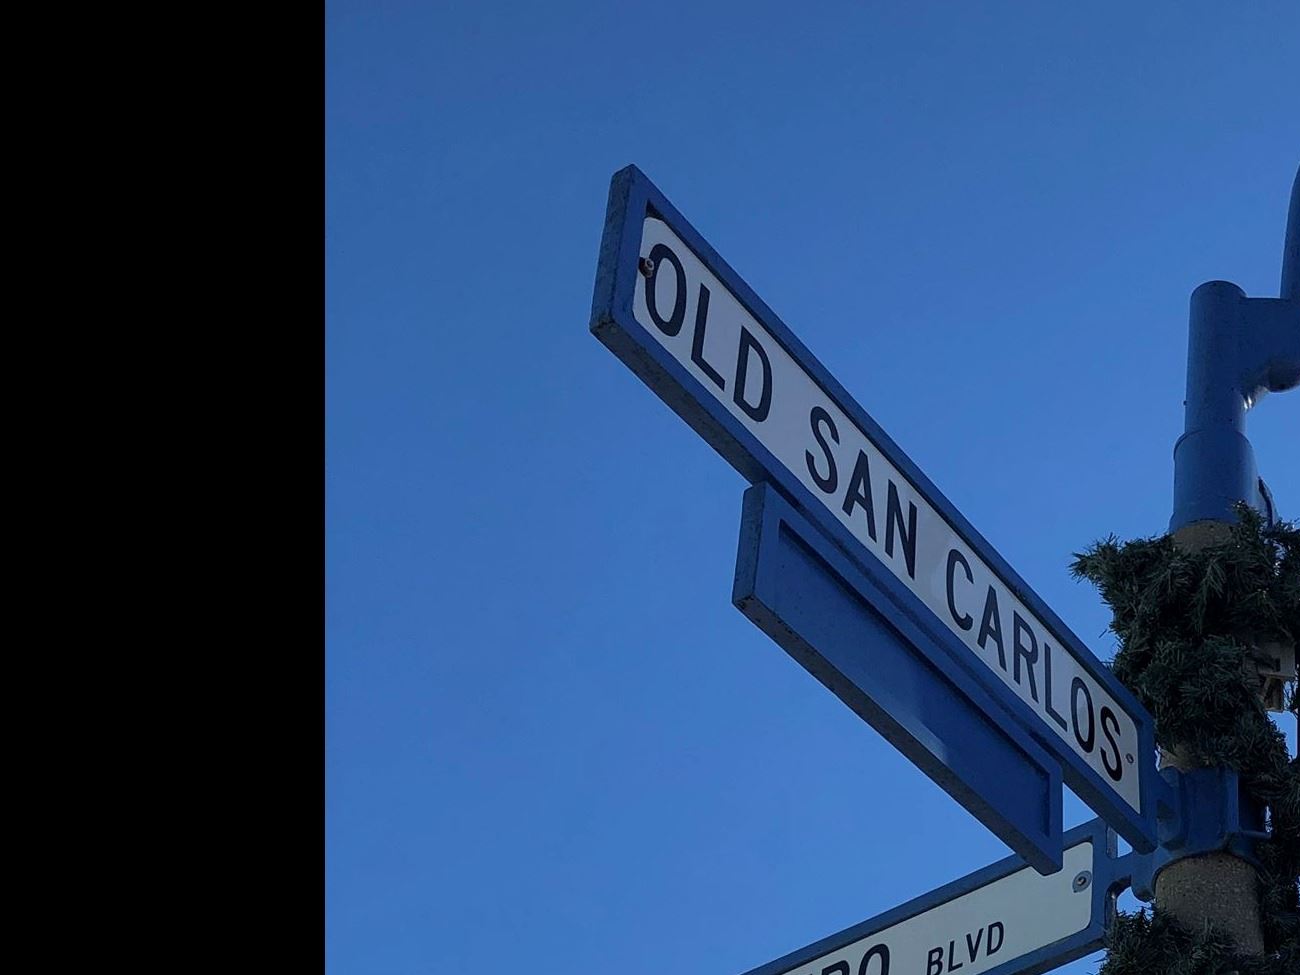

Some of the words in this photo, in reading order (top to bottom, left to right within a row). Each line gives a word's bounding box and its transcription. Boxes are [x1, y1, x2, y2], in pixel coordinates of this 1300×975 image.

[645, 243, 773, 422] OLD
[805, 406, 918, 579] SAN
[946, 549, 1123, 782] CARLOS
